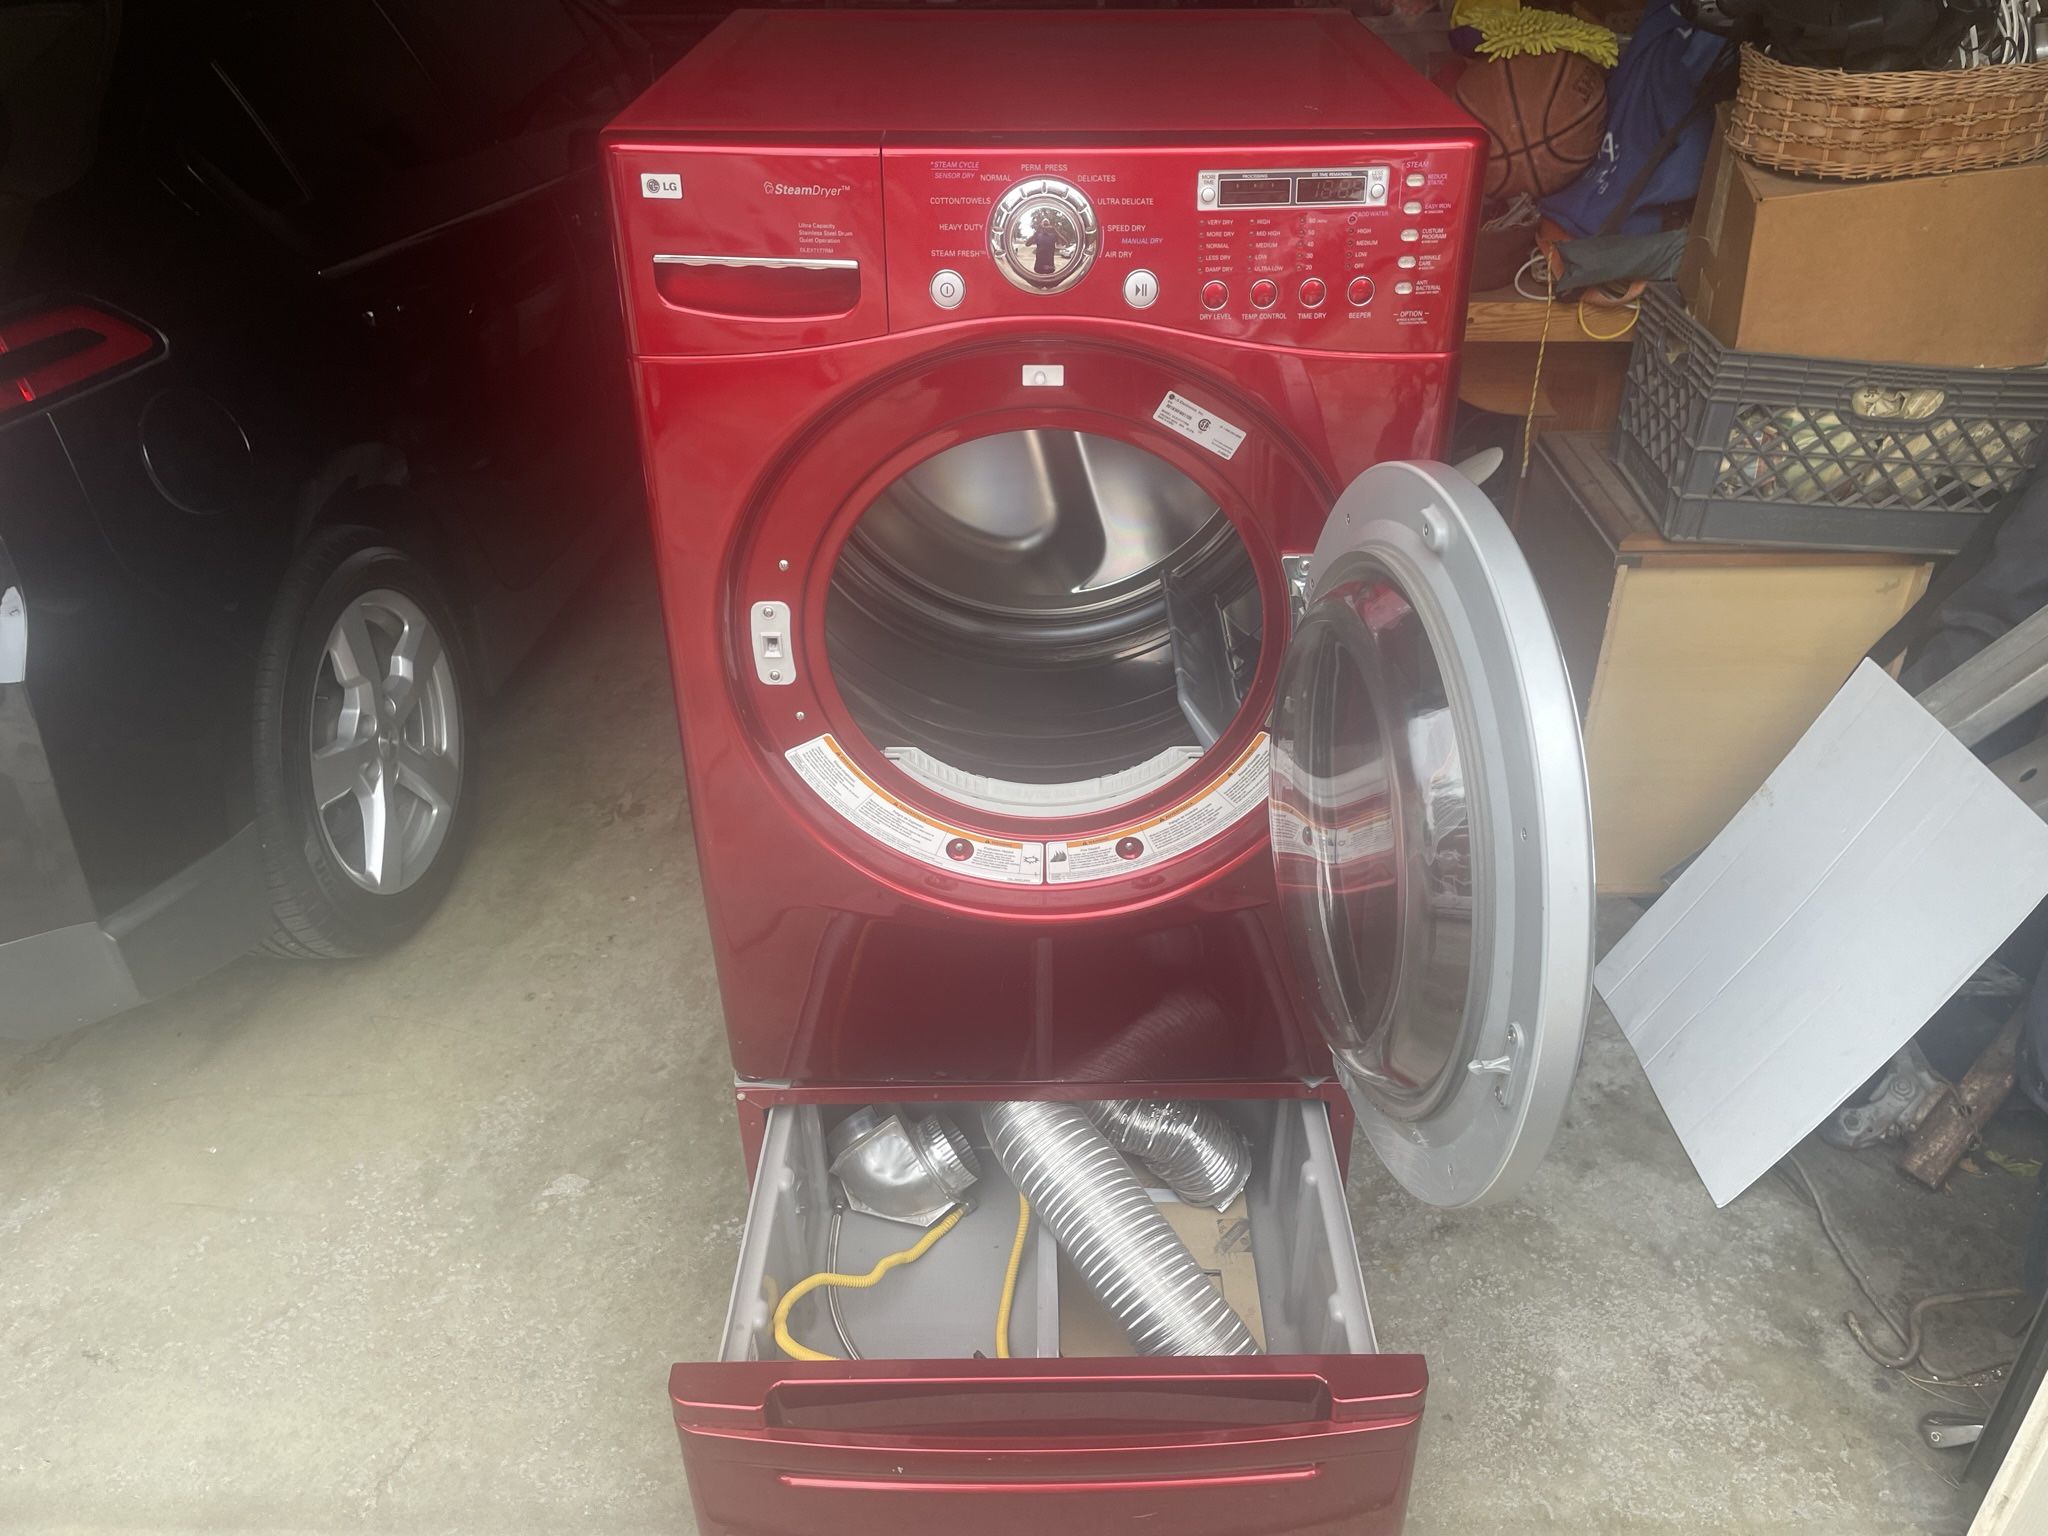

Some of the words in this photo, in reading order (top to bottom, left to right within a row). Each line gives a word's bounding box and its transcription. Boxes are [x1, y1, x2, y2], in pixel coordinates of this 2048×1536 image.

[958, 161, 979, 169] CYCLE
[662, 182, 677, 191] LG
[930, 197, 991, 205] COTTON/TOWELS
[1097, 197, 1120, 205] ULTRA
[1121, 197, 1154, 205] DELICATE
[939, 223, 963, 231] HEAVY
[963, 223, 984, 231] DUTY
[1107, 224, 1130, 232] SPEED
[1131, 224, 1146, 232] DRY
[931, 249, 956, 257] STEAM
[1259, 312, 1287, 320] CONTROL
